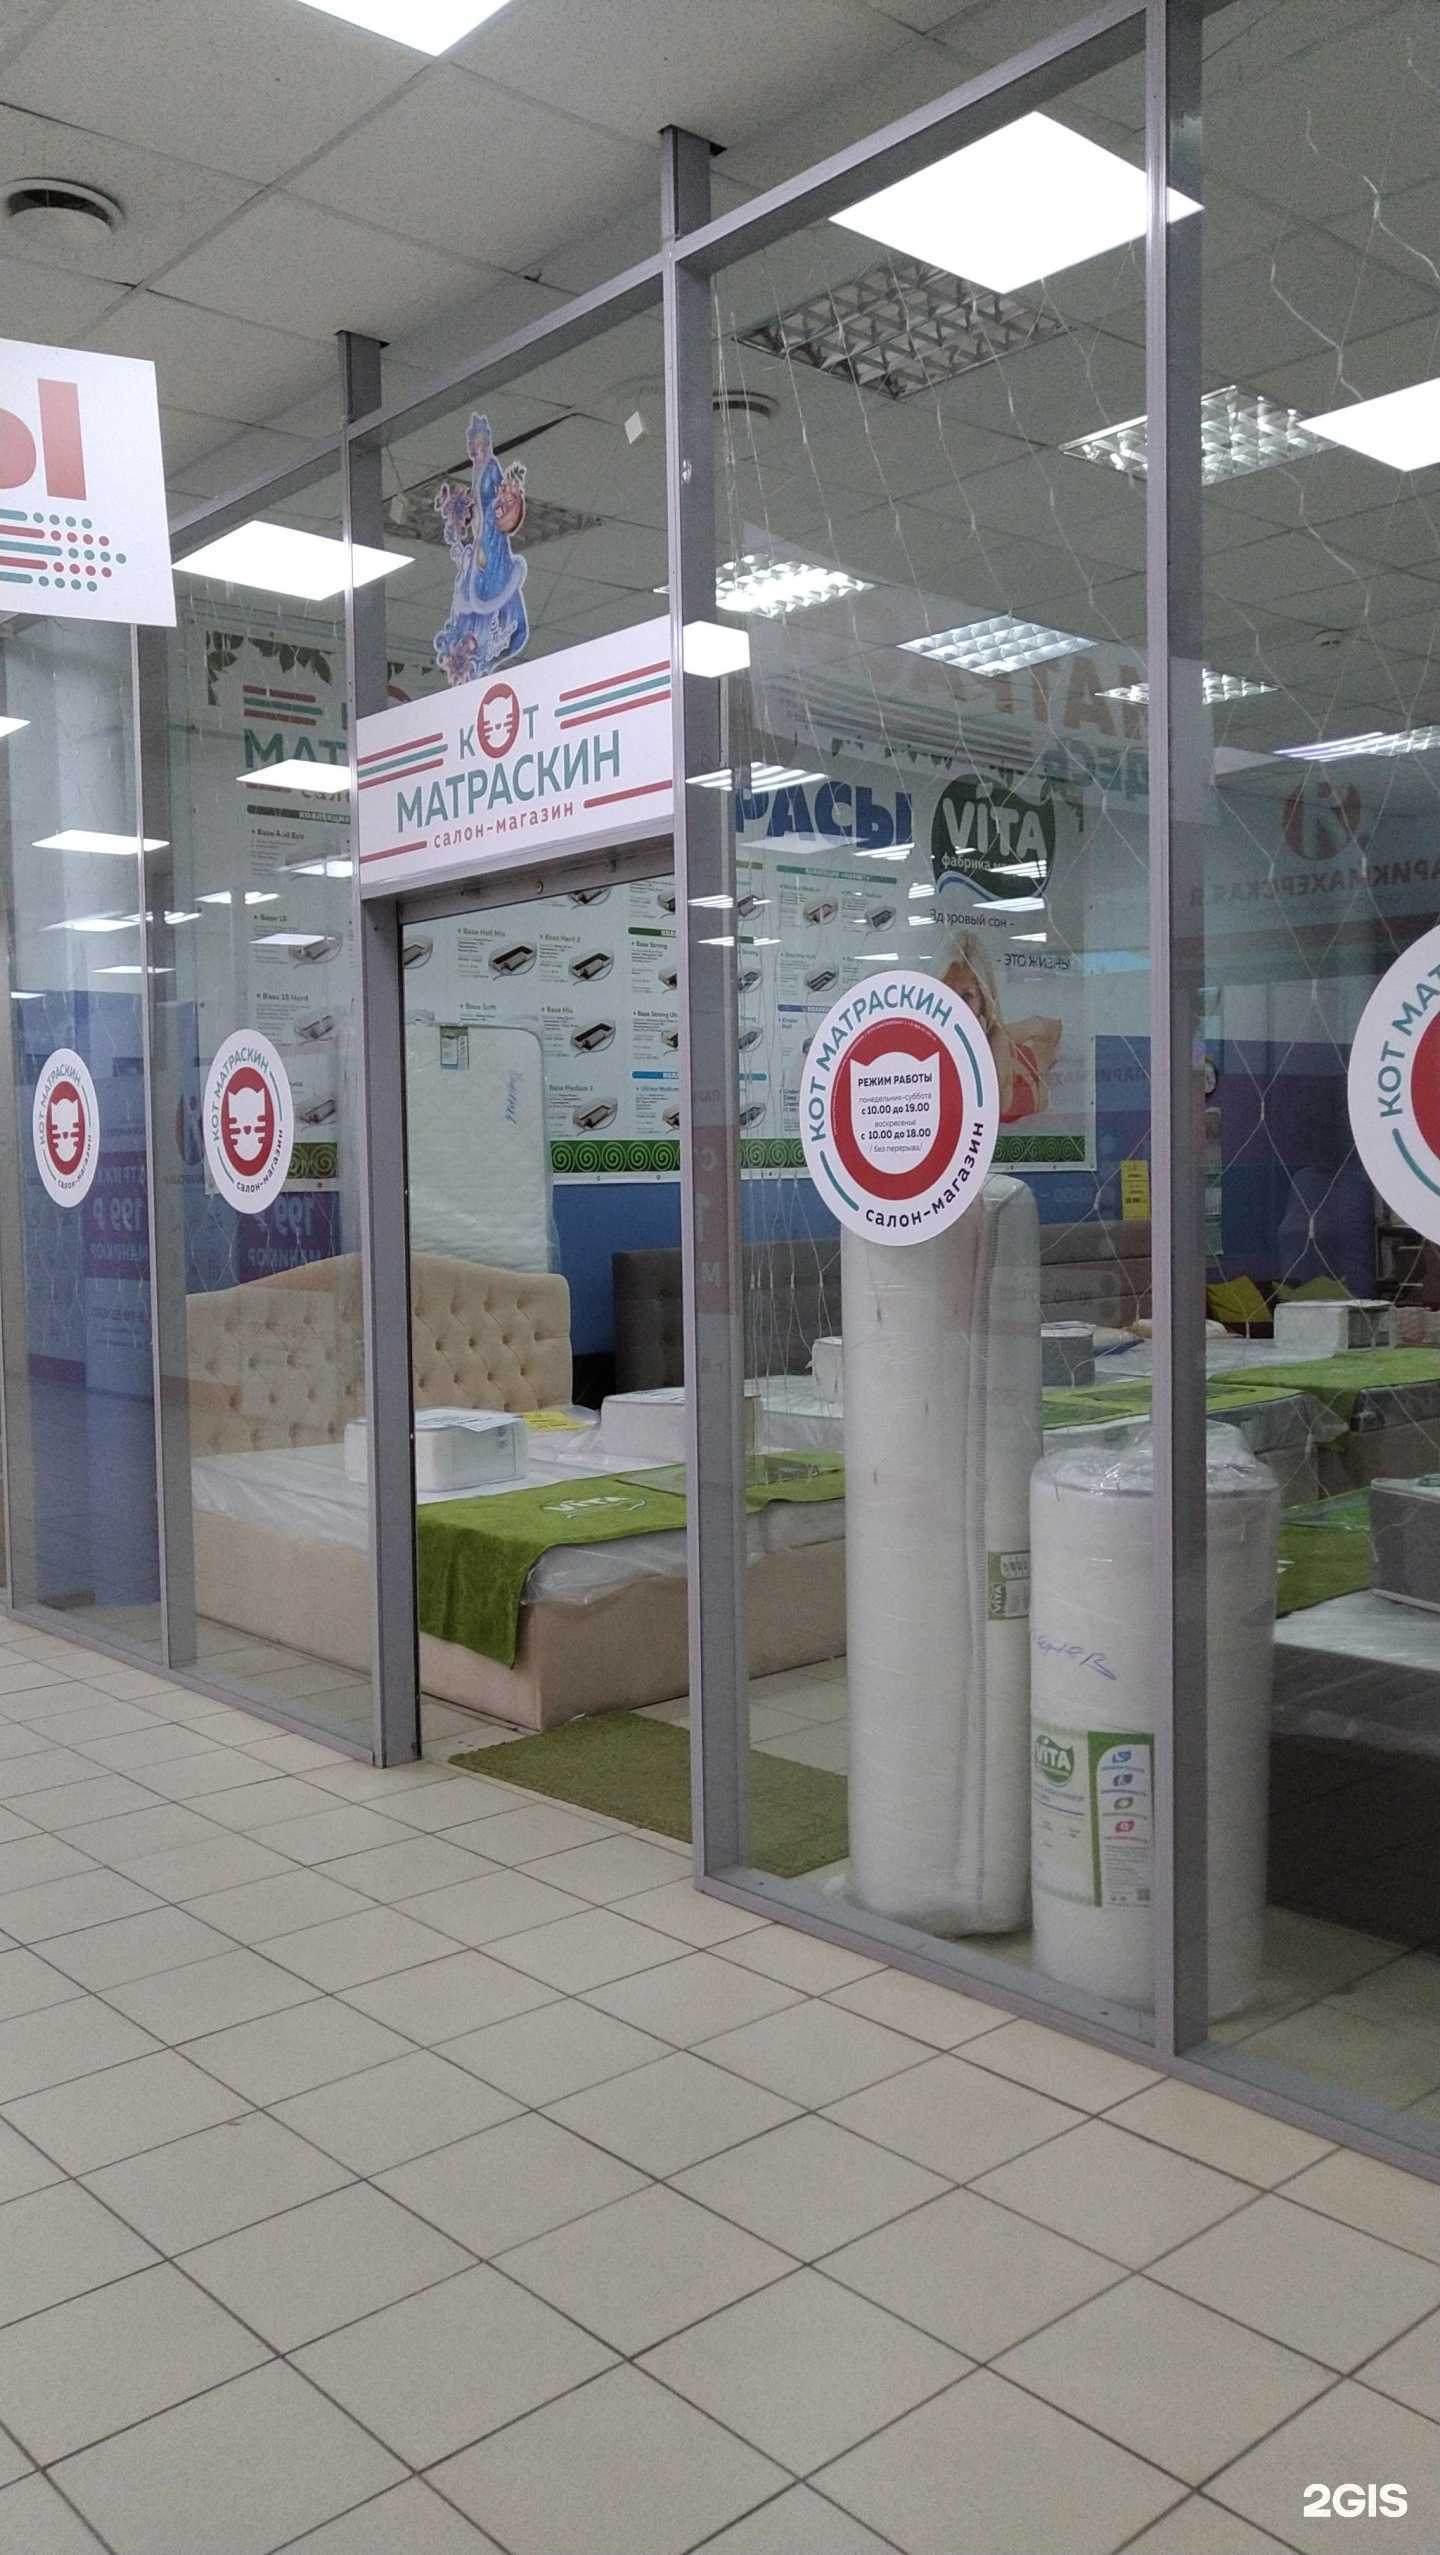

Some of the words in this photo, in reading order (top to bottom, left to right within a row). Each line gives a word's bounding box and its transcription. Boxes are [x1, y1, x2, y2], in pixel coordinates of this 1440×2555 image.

[459, 682, 540, 760] КОТ
[396, 728, 622, 834] МАТРАСКИН
[433, 800, 574, 849] салон-магазин
[941, 852, 990, 871] фабрика
[989, 917, 1008, 928] сон
[1004, 953, 1026, 968] ЭТО
[815, 983, 953, 1073] МАТРАСКИН
[40, 1063, 82, 1109] МАТРАСКИН
[214, 1047, 270, 1099] МАТРАСКИН
[858, 1076, 892, 1087] РЕЖИМ
[893, 1072, 932, 1085] РАБОТЫ
[1377, 1040, 1406, 1118] КОТ
[808, 1076, 827, 1142] КОТ
[859, 1092, 932, 1104] понедельник-суббота
[867, 1104, 891, 1115] 10.00
[892, 1106, 903, 1115] до
[905, 1102, 930, 1113] 19.00
[38, 1109, 47, 1146] КОТ
[209, 1103, 221, 1142] КОТ
[868, 1129, 892, 1140] 10.00
[893, 1131, 904, 1139] до
[906, 1128, 931, 1138] 18.00
[874, 1119, 917, 1128] воскресенье
[57, 1133, 92, 1190] салон-магазин
[235, 1128, 285, 1193] салон-магазин
[866, 1121, 985, 1229] салон-магазин
